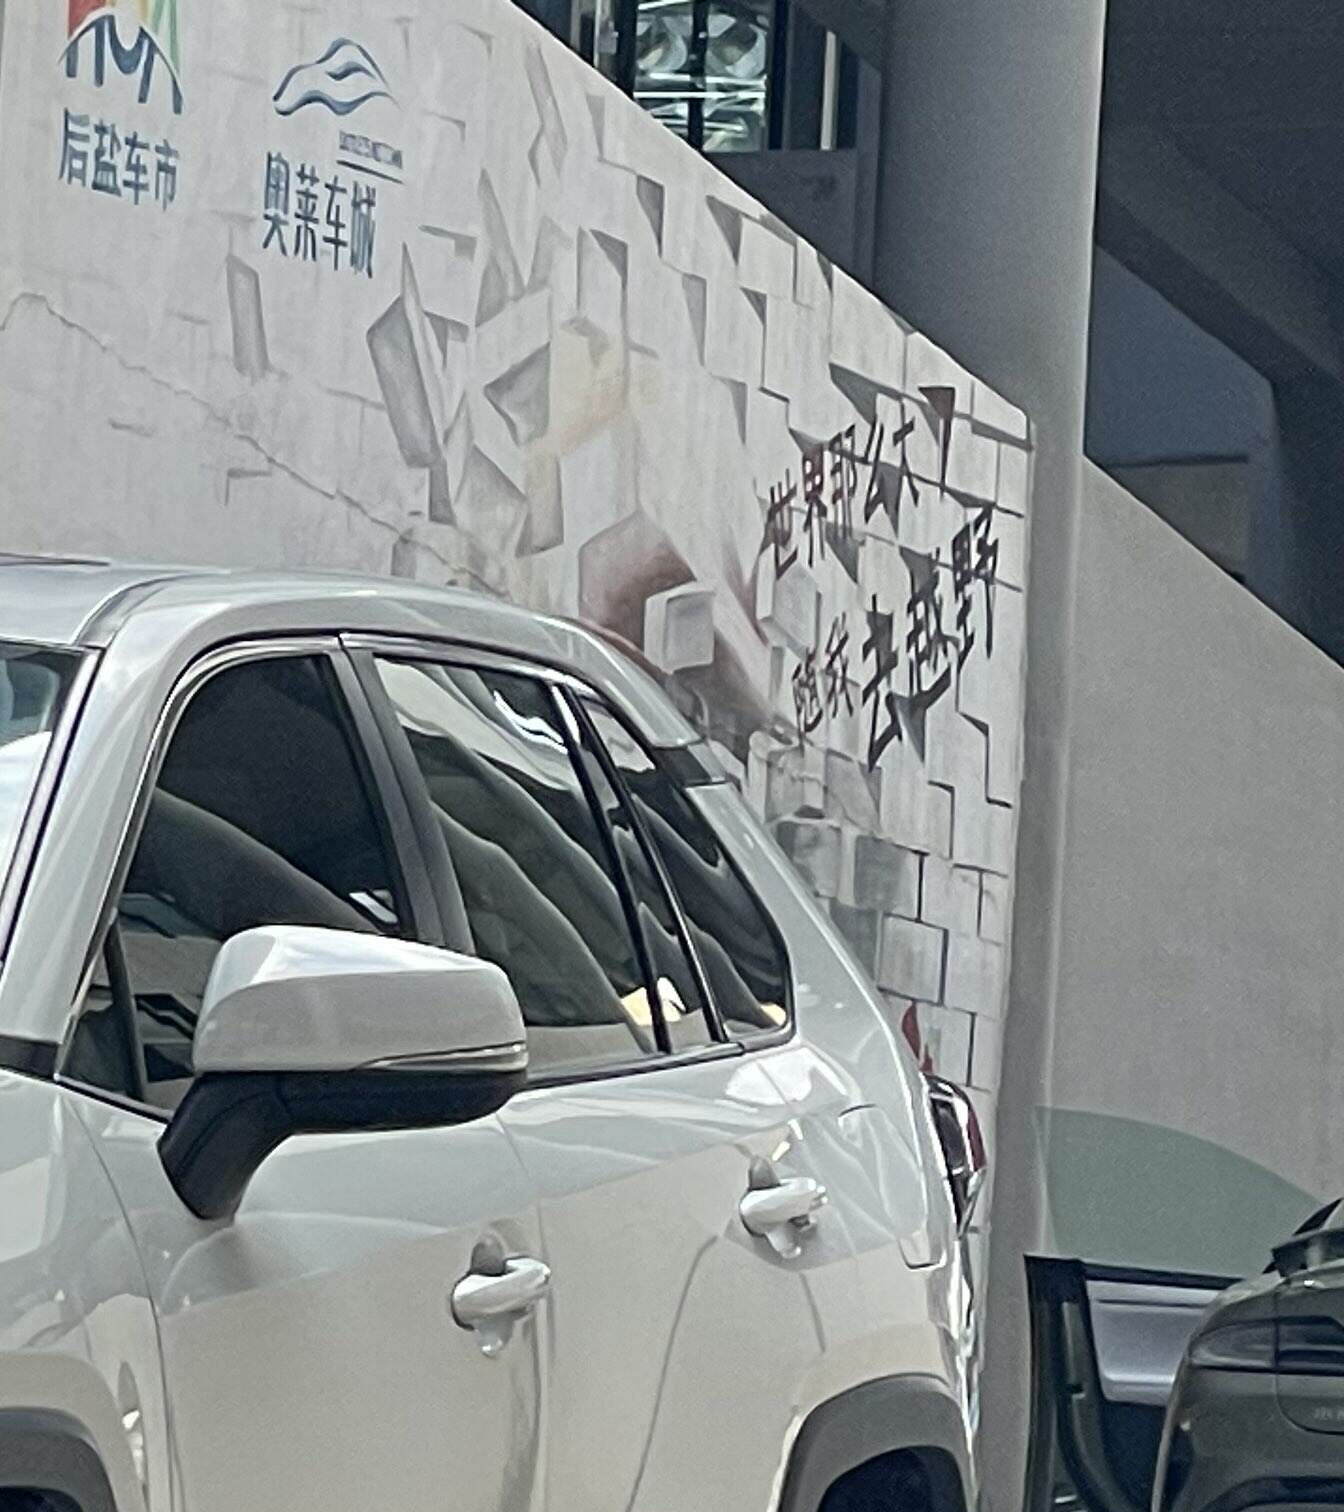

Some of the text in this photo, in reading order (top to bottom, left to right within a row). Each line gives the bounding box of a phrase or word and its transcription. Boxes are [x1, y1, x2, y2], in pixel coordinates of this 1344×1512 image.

[59, 107, 180, 211] 后盐车市
[263, 152, 376, 279] 奥莱车城
[766, 400, 919, 580] 世界那么大
